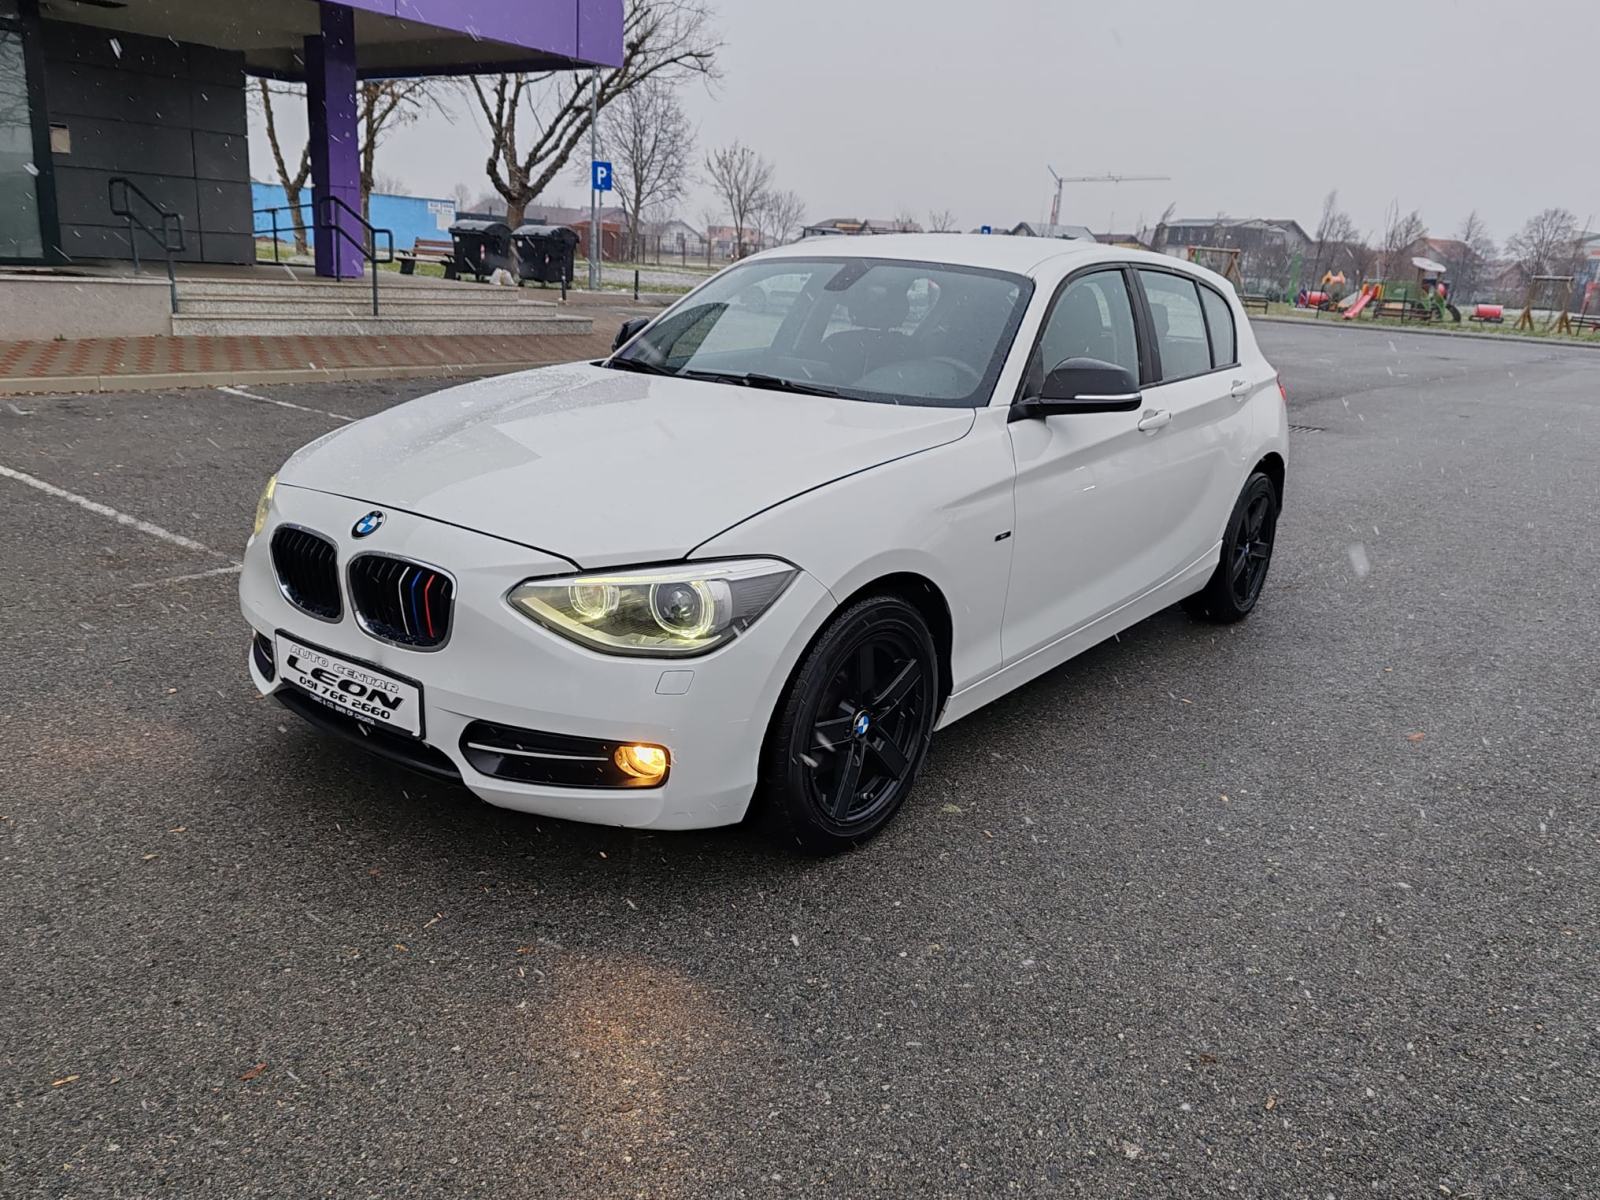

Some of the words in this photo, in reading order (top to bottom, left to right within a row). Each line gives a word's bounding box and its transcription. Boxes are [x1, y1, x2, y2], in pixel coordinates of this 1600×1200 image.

[597, 166, 607, 185] P
[286, 654, 404, 711] LEON
[290, 644, 329, 668] AUTO
[333, 663, 400, 694] CENTAR
[299, 676, 318, 691] 091
[321, 685, 348, 703] 766
[351, 698, 391, 720] 2660
